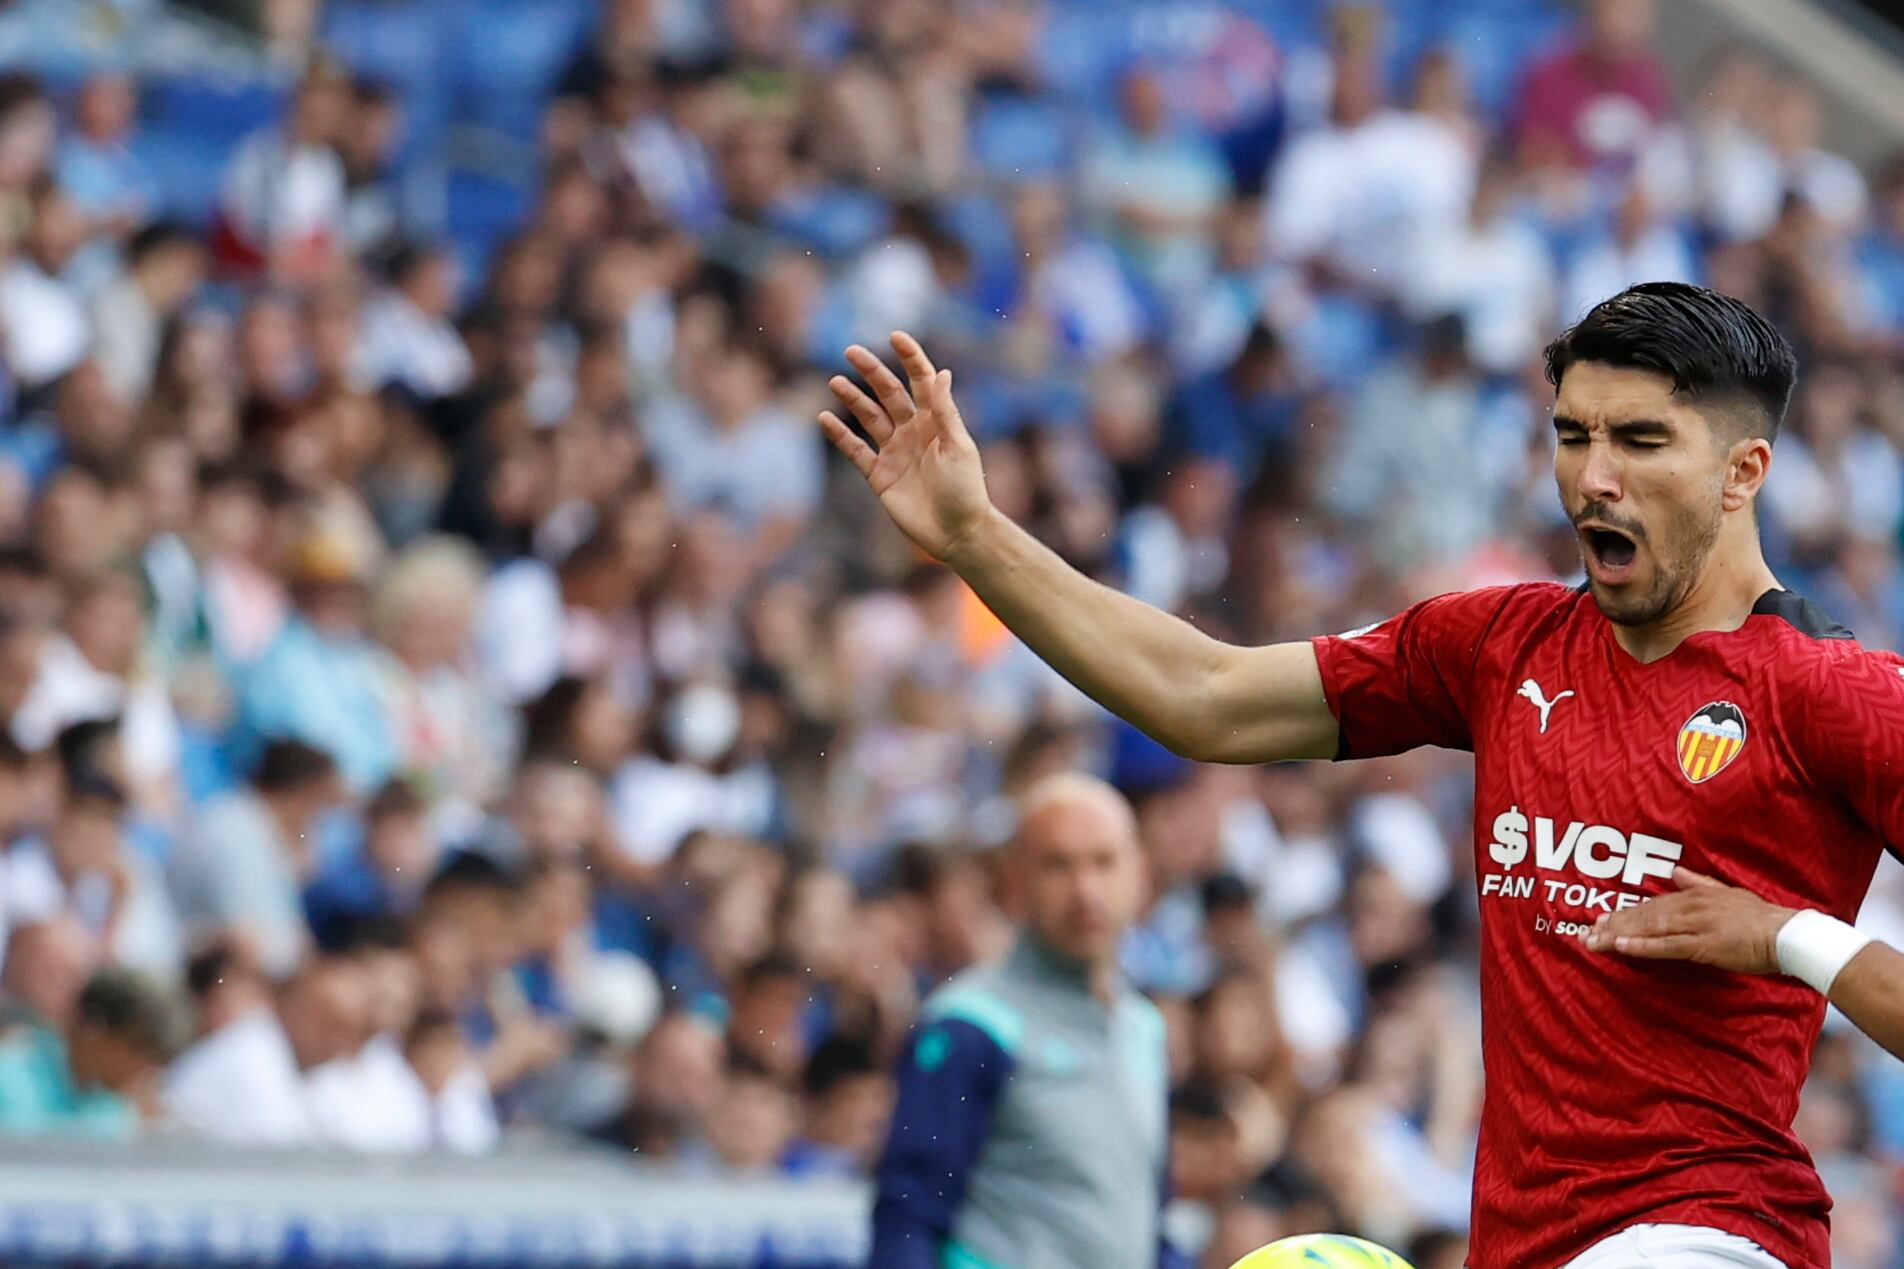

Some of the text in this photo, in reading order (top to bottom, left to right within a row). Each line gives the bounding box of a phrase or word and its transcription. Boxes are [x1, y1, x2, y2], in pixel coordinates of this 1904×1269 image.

[1489, 805, 1682, 886] $VCF
[1481, 873, 1652, 913] FAN TOKE
[1535, 913, 1551, 935] by
